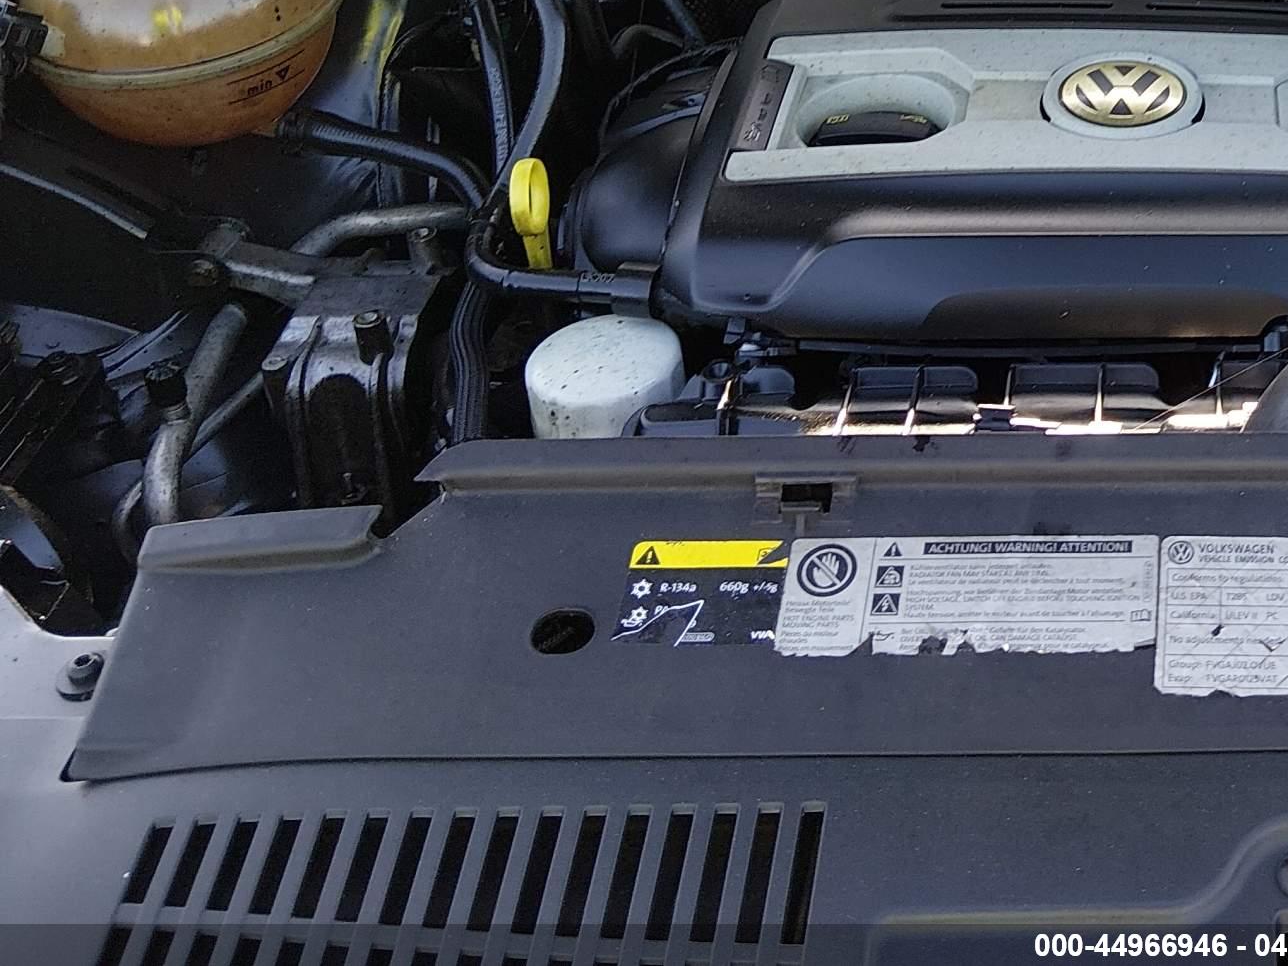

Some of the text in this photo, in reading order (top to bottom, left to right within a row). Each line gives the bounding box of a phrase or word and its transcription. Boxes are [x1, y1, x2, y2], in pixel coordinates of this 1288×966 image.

[247, 79, 273, 96] min
[927, 541, 1129, 554] ACHTUNG! WARNING! ATTENTION!
[1199, 543, 1275, 555] VOLKSWAGEN
[1199, 555, 1232, 563] VEHICLE
[1234, 555, 1275, 564] EMISSION
[659, 582, 697, 593] R-134a
[719, 581, 750, 594] 660g
[1170, 610, 1216, 620] California
